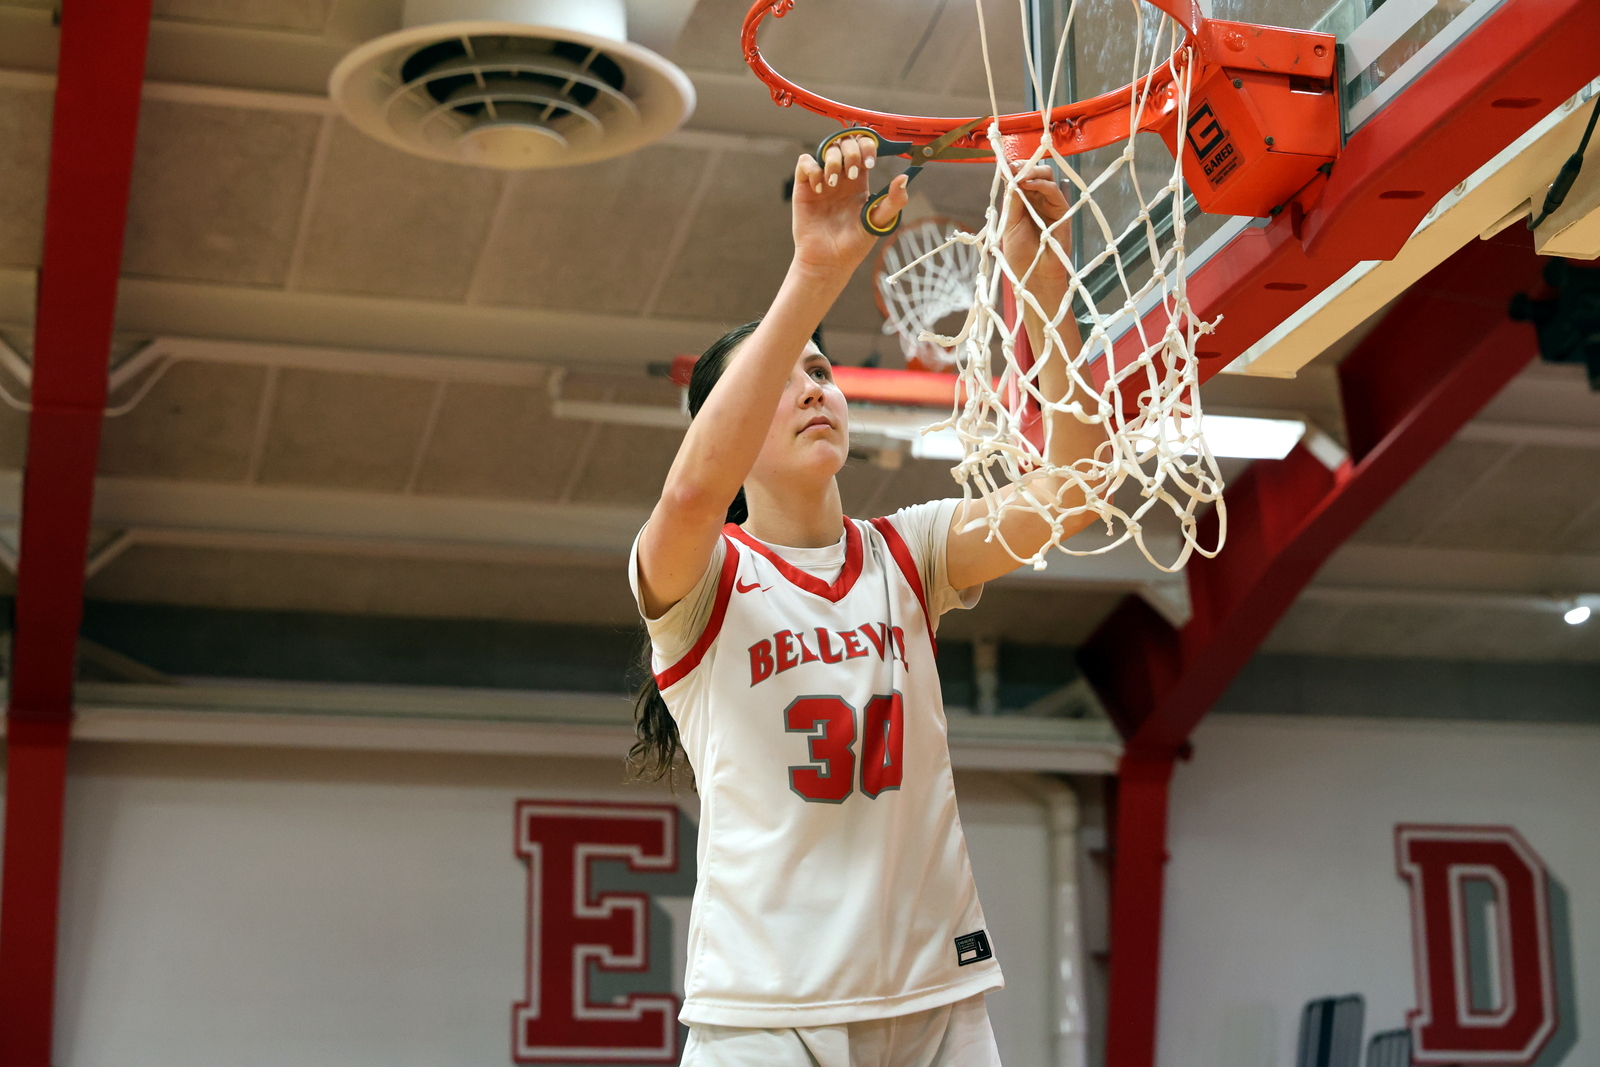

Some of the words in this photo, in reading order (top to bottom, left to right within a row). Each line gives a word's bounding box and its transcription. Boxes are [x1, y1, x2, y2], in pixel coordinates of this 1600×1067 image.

[1203, 143, 1234, 176] GARED
[783, 689, 904, 804] 30
[512, 798, 680, 1064] E
[1393, 822, 1559, 1067] D
